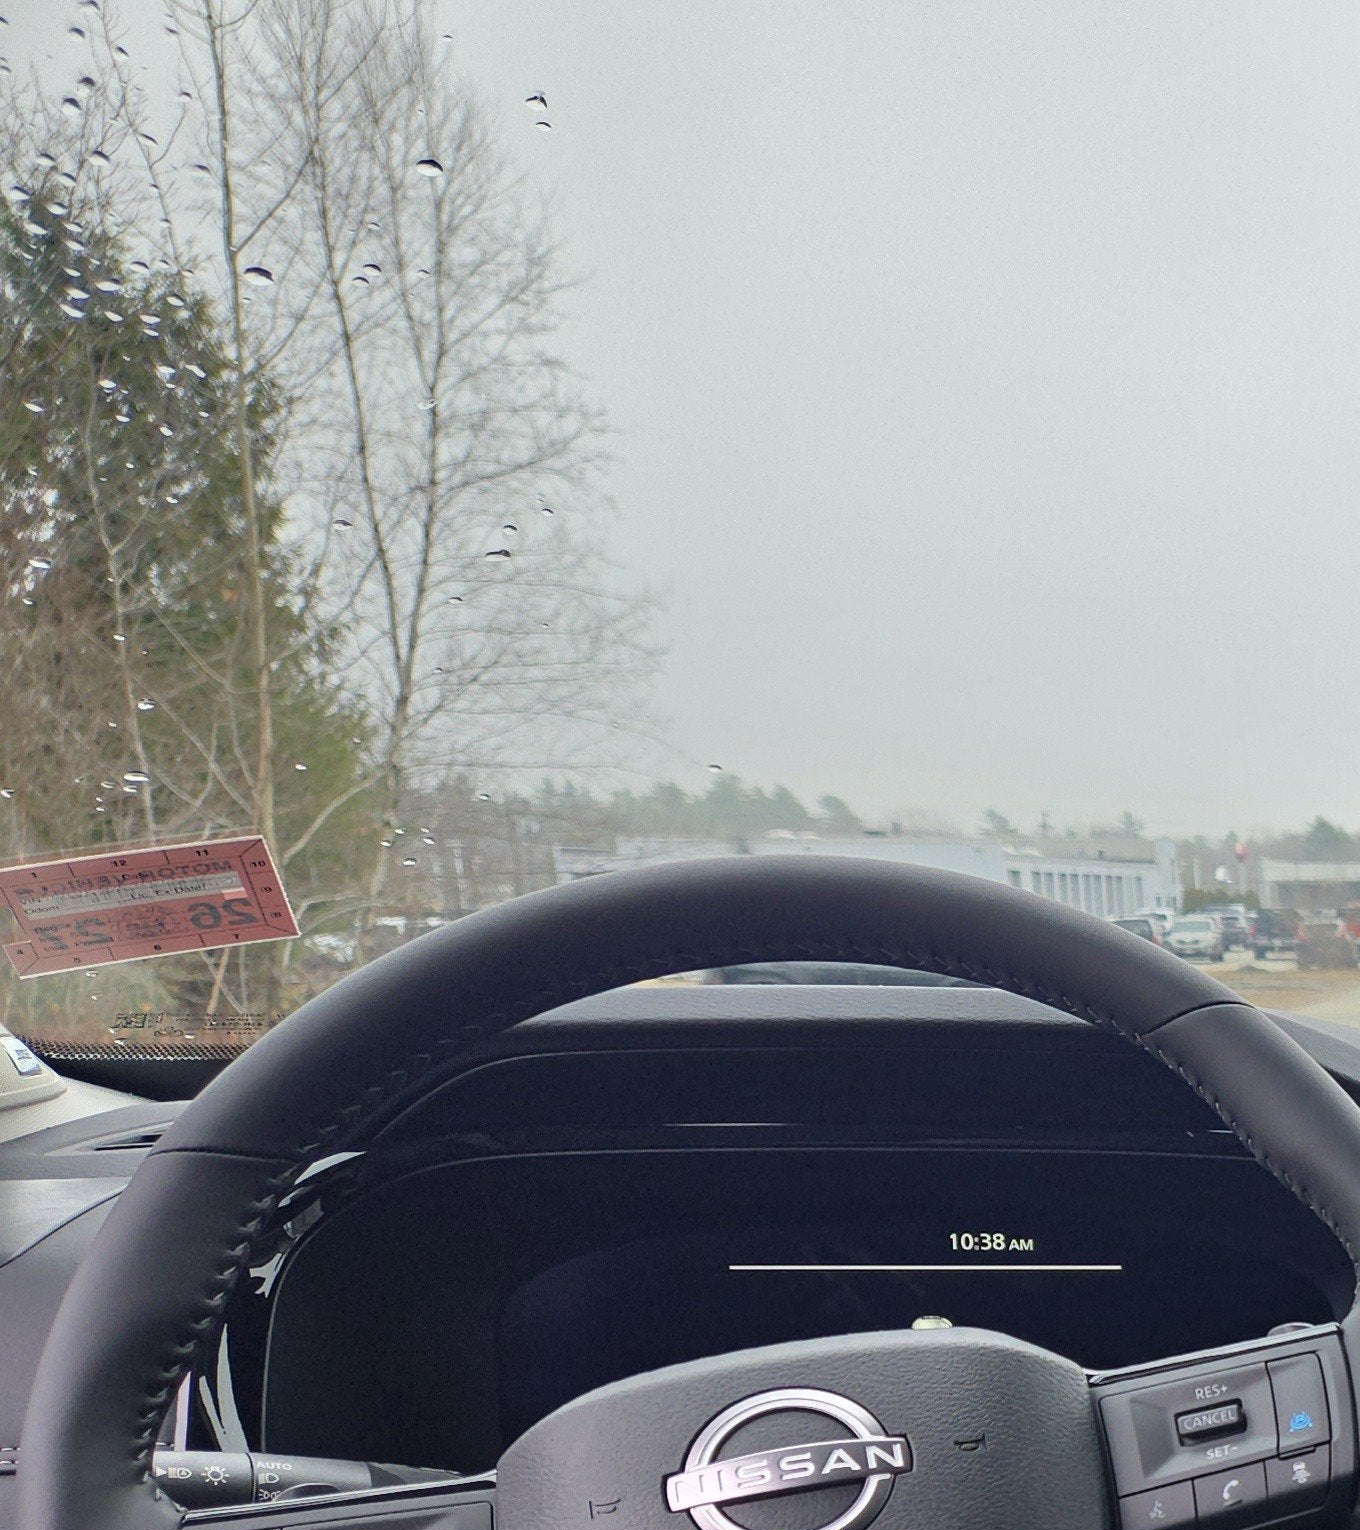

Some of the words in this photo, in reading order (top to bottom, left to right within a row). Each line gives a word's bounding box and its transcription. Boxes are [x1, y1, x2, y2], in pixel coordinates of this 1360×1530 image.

[949, 1233, 1006, 1251] 10:38
[1008, 1238, 1034, 1251] AM
[1194, 1384, 1228, 1400] RES+
[1183, 1409, 1237, 1430] CANCEL
[256, 1461, 293, 1471] AUTO
[675, 1443, 905, 1503] NISSAN
